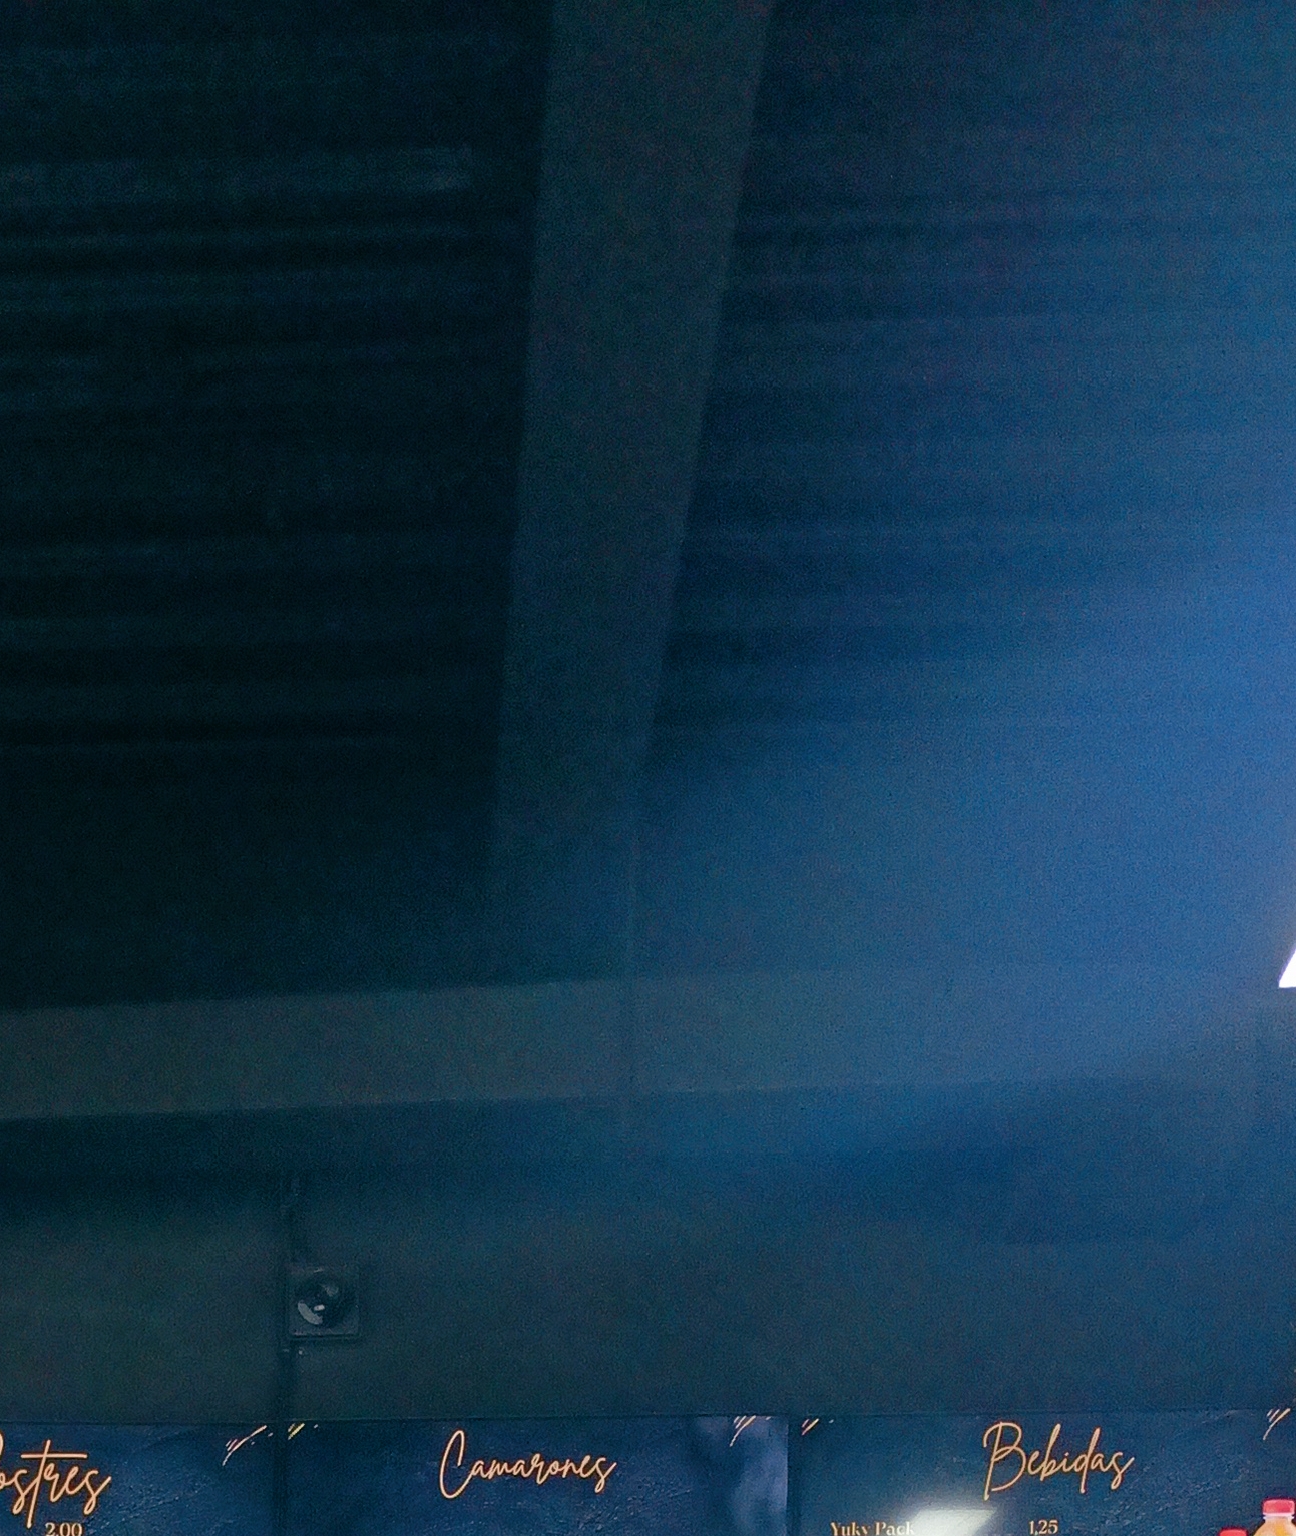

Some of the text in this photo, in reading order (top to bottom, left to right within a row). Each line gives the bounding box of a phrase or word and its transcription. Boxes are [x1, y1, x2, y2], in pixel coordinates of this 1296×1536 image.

[439, 1430, 617, 1499] Camarones
[982, 1422, 1135, 1501] Bebidas
[874, 1522, 915, 1536] Pack
[1028, 1520, 1059, 1536] 1,25
